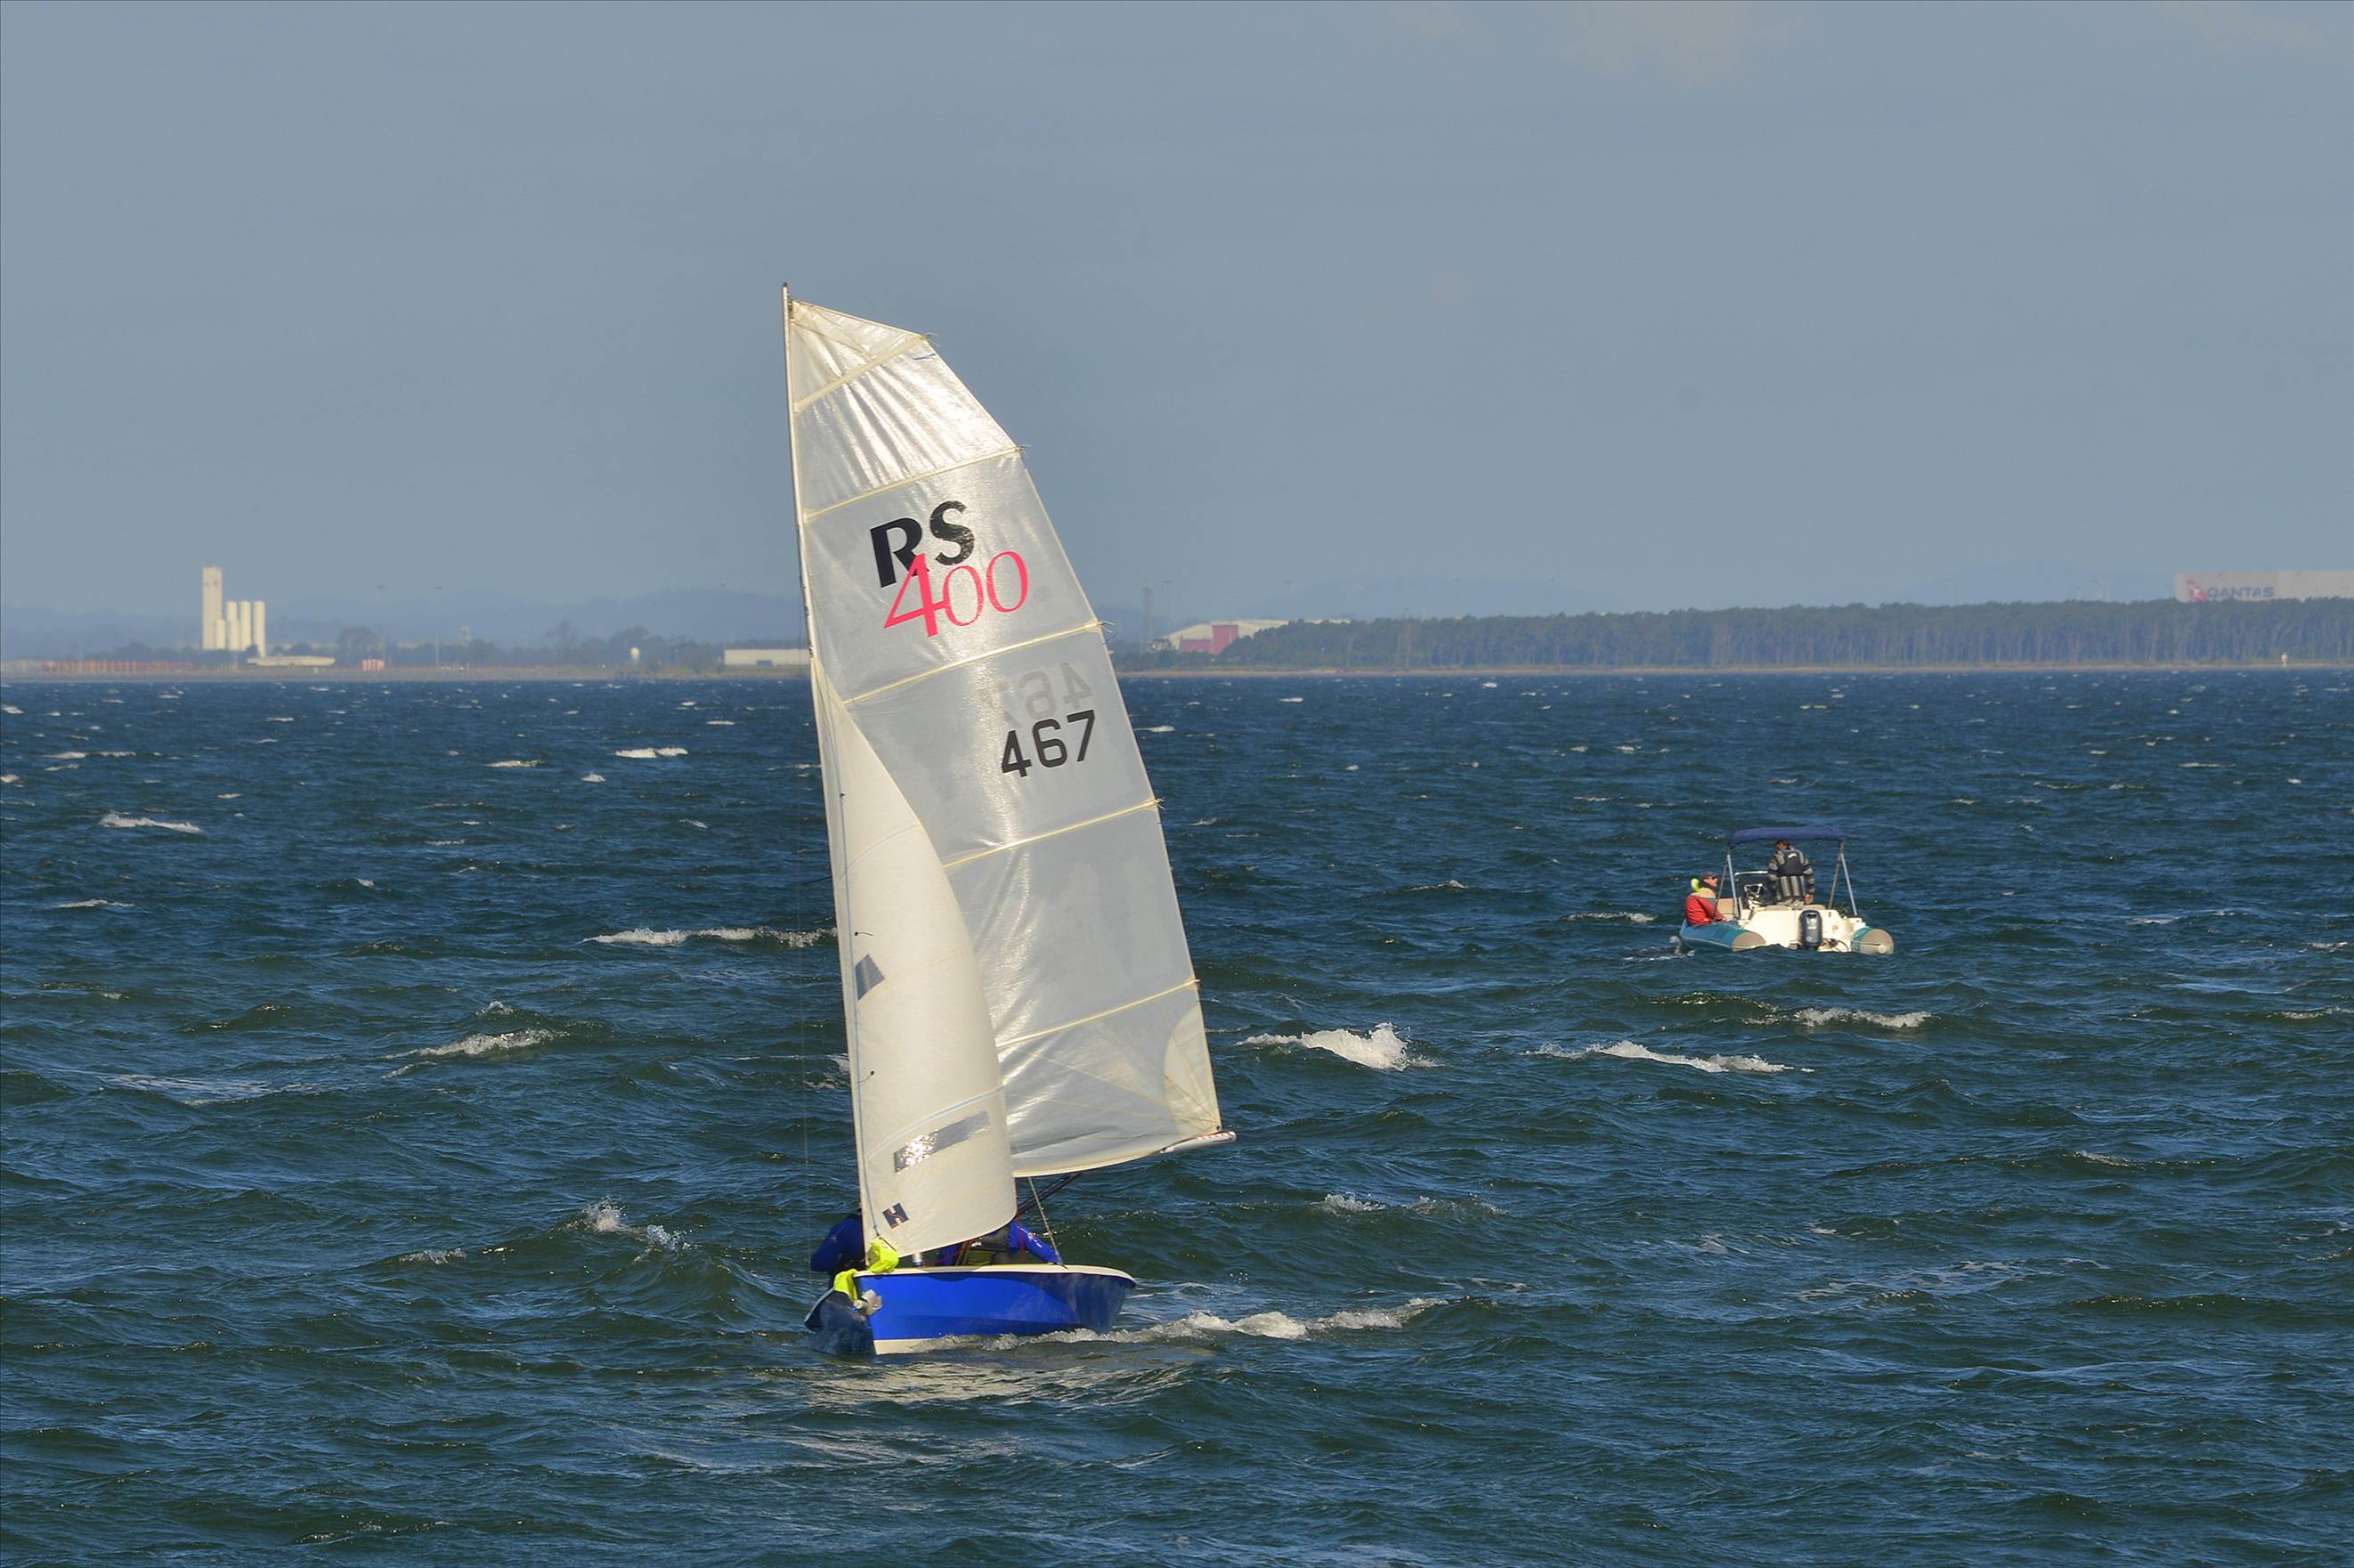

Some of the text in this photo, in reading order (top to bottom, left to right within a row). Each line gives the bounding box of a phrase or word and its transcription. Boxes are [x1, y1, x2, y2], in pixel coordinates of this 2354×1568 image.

[870, 500, 975, 588] RS
[883, 550, 1029, 638] 400
[2207, 586, 2275, 599] QANTAS
[1001, 709, 1096, 778] 467
